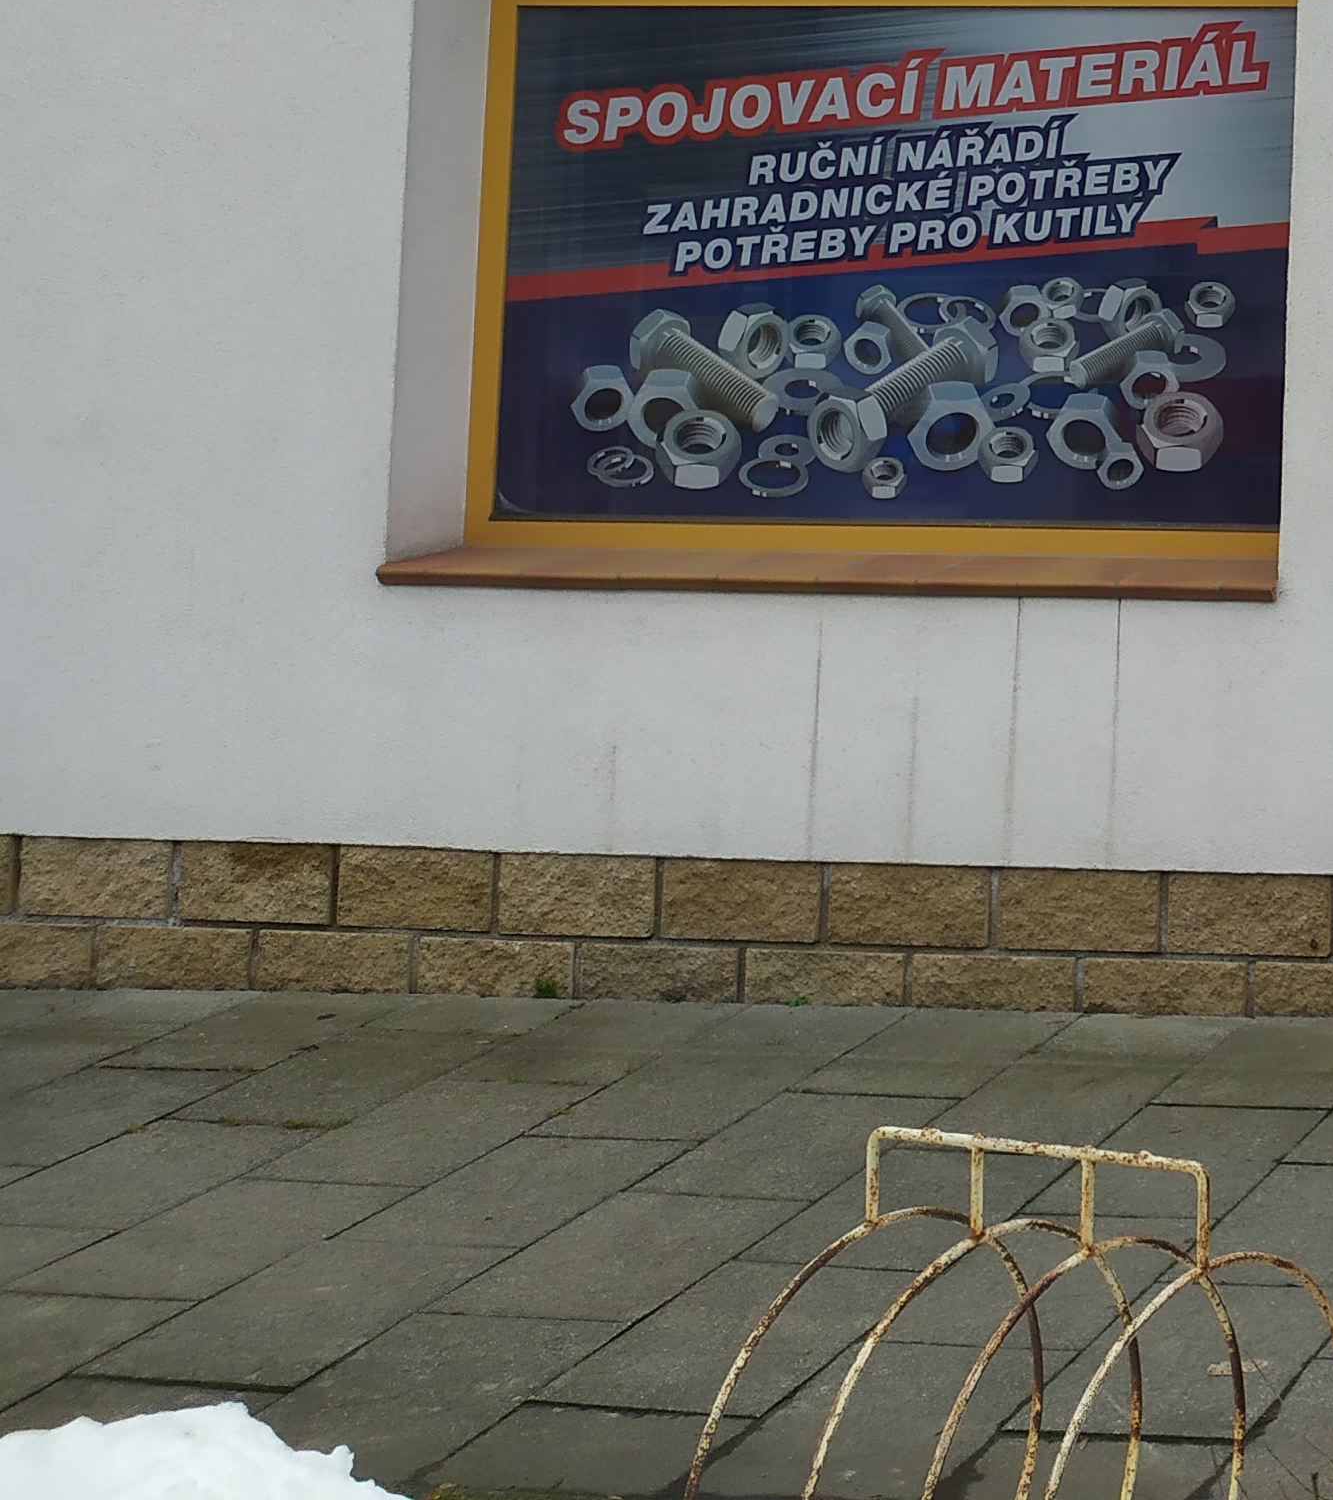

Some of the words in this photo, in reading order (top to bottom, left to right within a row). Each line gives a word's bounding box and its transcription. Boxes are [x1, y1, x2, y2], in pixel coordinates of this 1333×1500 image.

[563, 56, 925, 144] SPOJOVACÍ
[941, 31, 1263, 108] MATERIÁL
[748, 136, 888, 186] RUČNÍ
[896, 121, 1063, 174] NÁŘADÍ
[643, 176, 952, 235] ZAHRADNICKÉ
[966, 156, 1172, 208] POTŘEBY
[674, 225, 876, 273] POTŘEBY
[889, 217, 976, 256] PRO
[993, 202, 1145, 245] KUTILY
